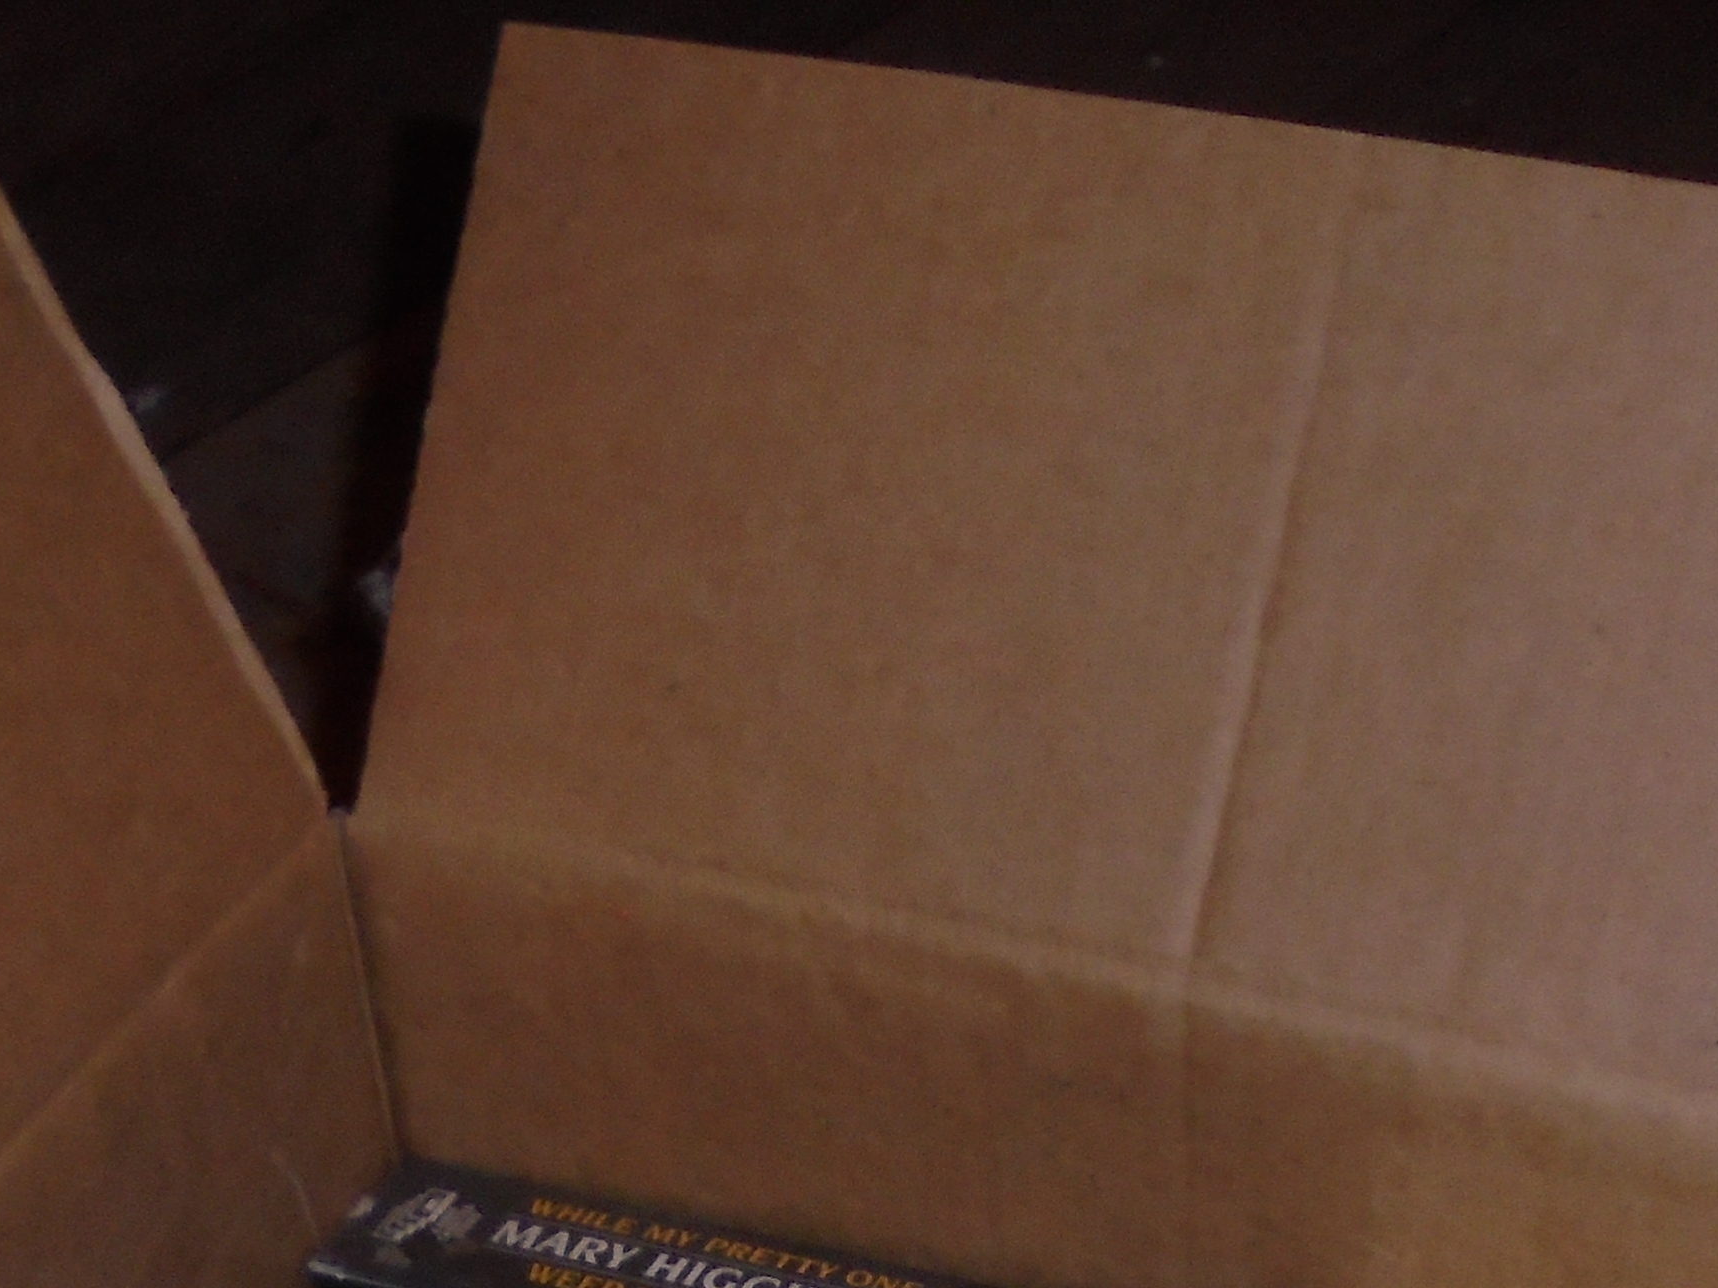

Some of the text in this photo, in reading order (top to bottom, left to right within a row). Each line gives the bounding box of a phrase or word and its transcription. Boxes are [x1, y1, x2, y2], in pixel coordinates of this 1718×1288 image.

[490, 1218, 640, 1270] MARY
[531, 1198, 638, 1236] WHILE
[644, 1222, 699, 1248] MY
[704, 1236, 840, 1280] PRETTY
